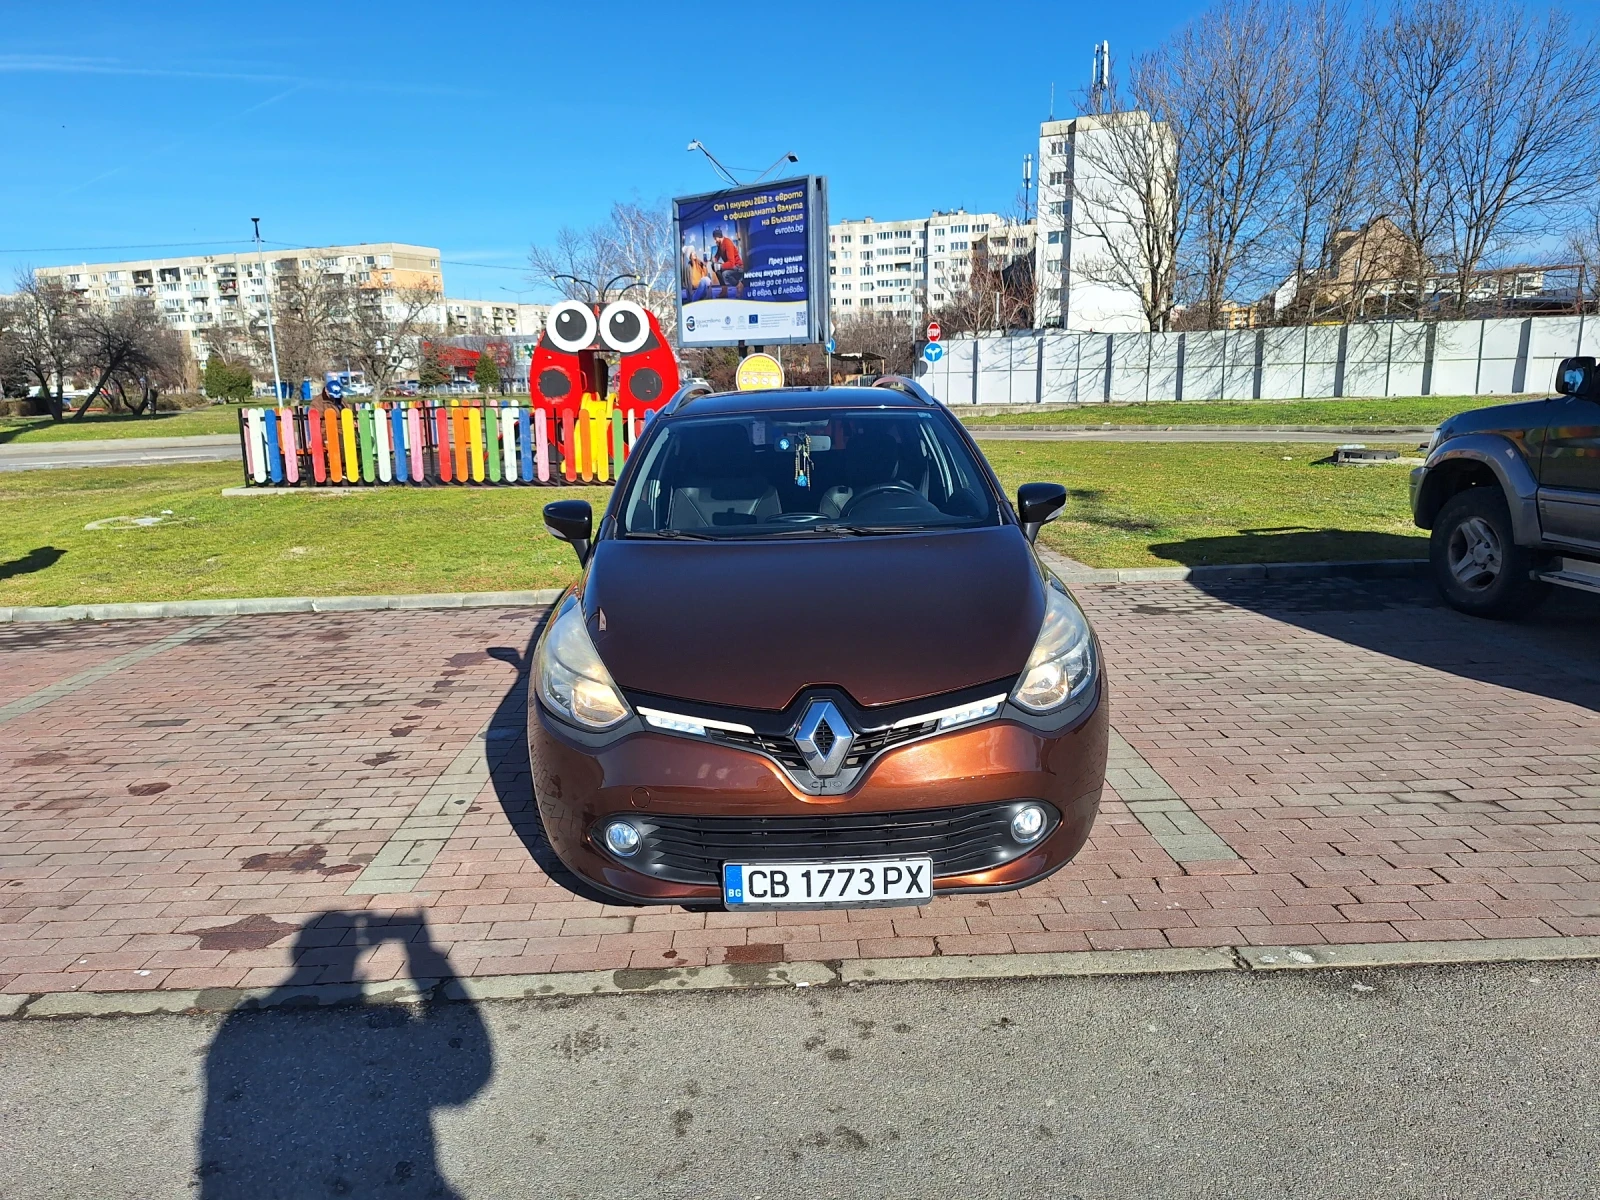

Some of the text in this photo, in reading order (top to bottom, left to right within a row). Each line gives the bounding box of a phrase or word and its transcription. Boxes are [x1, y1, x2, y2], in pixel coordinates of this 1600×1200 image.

[713, 203, 725, 212] От
[726, 201, 730, 210] 1
[730, 200, 754, 210] януари
[754, 196, 767, 205] 2026
[775, 190, 803, 202] еврото
[729, 206, 776, 220] официалната
[777, 202, 803, 213] валута
[771, 214, 803, 225] България
[774, 224, 804, 235] evroto.bg
[768, 254, 803, 266] През целия
[763, 268, 785, 278] януари
[750, 279, 765, 287] може
[766, 280, 774, 288] да
[783, 276, 803, 284] плаща
[778, 286, 782, 295] в
[928, 328, 940, 336] STOP
[748, 865, 924, 898] CB 1773 PX
[728, 888, 742, 898] BG
